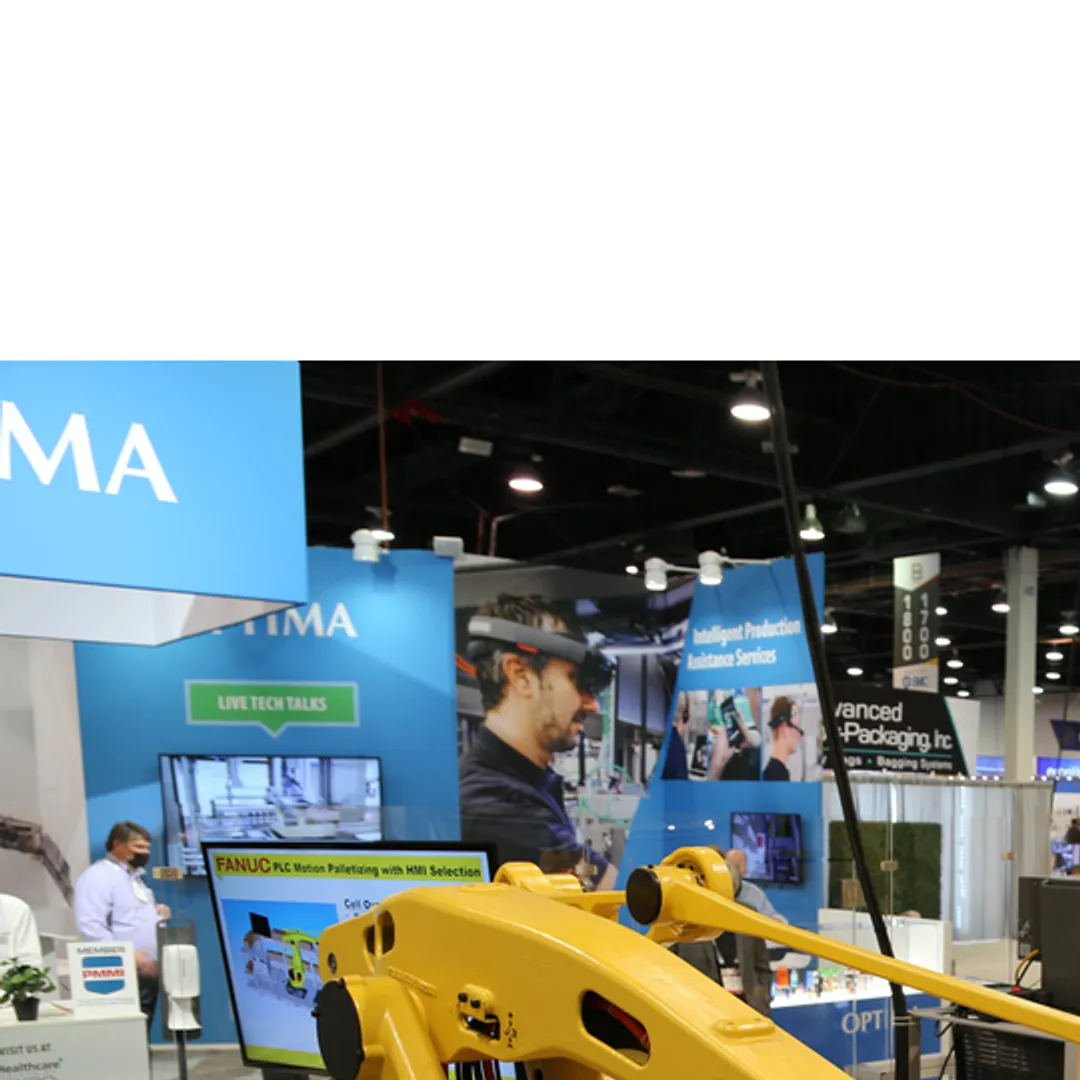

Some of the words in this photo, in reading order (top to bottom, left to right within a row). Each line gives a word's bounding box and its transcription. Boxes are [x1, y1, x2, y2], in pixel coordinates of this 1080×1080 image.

[745, 616, 801, 639] Production
[736, 647, 777, 667] Services
[217, 695, 248, 711] LIVE
[249, 695, 284, 711] TECH
[286, 696, 328, 712] TALKS
[216, 856, 271, 873] FANUC
[273, 861, 291, 873] PLC
[294, 863, 326, 873] Motion
[328, 864, 379, 878] Palletizing
[381, 865, 403, 876] with
[406, 866, 427, 875] HMI
[429, 866, 482, 877] Selection
[83, 968, 125, 980] PMMI
[841, 1009, 889, 1034] OPT
